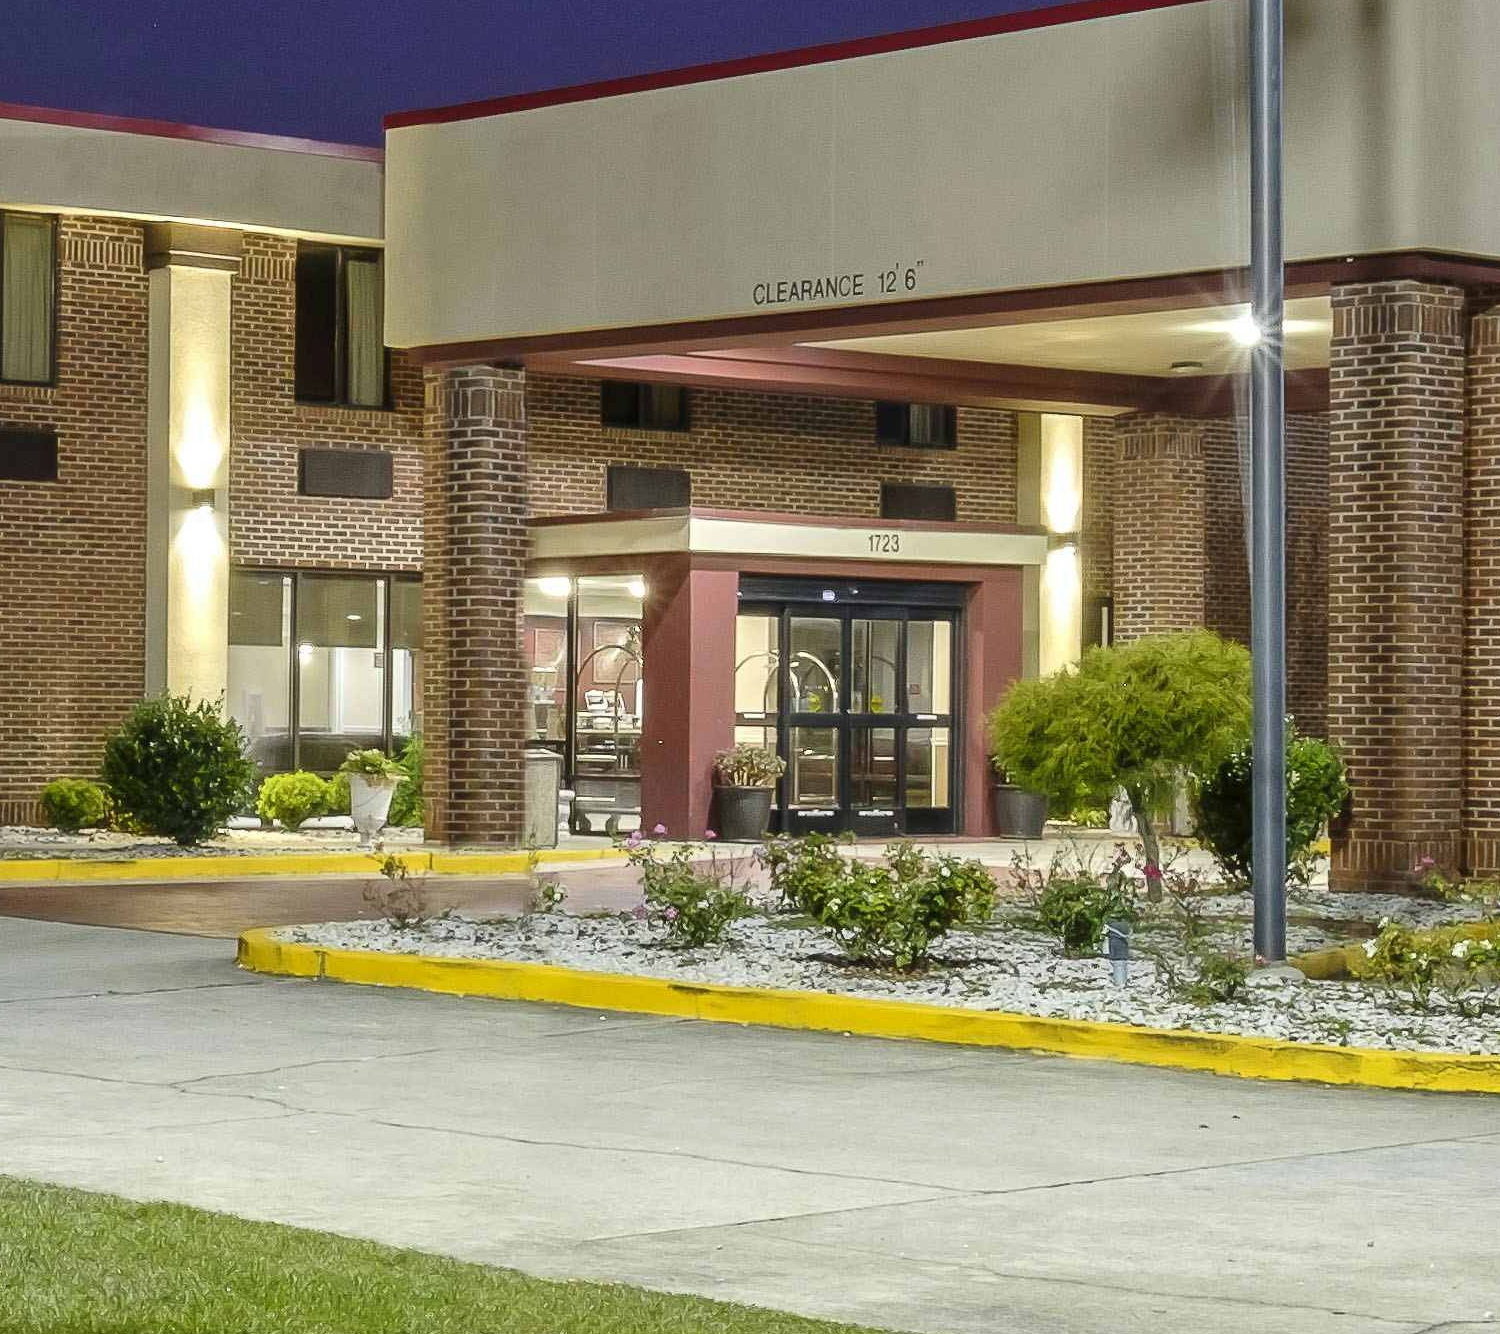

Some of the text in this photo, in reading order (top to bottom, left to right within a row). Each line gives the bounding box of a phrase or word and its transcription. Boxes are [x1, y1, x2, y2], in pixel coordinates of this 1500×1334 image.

[753, 260, 924, 305] CLEARANCE 12' 6"
[868, 534, 900, 553] 1723
